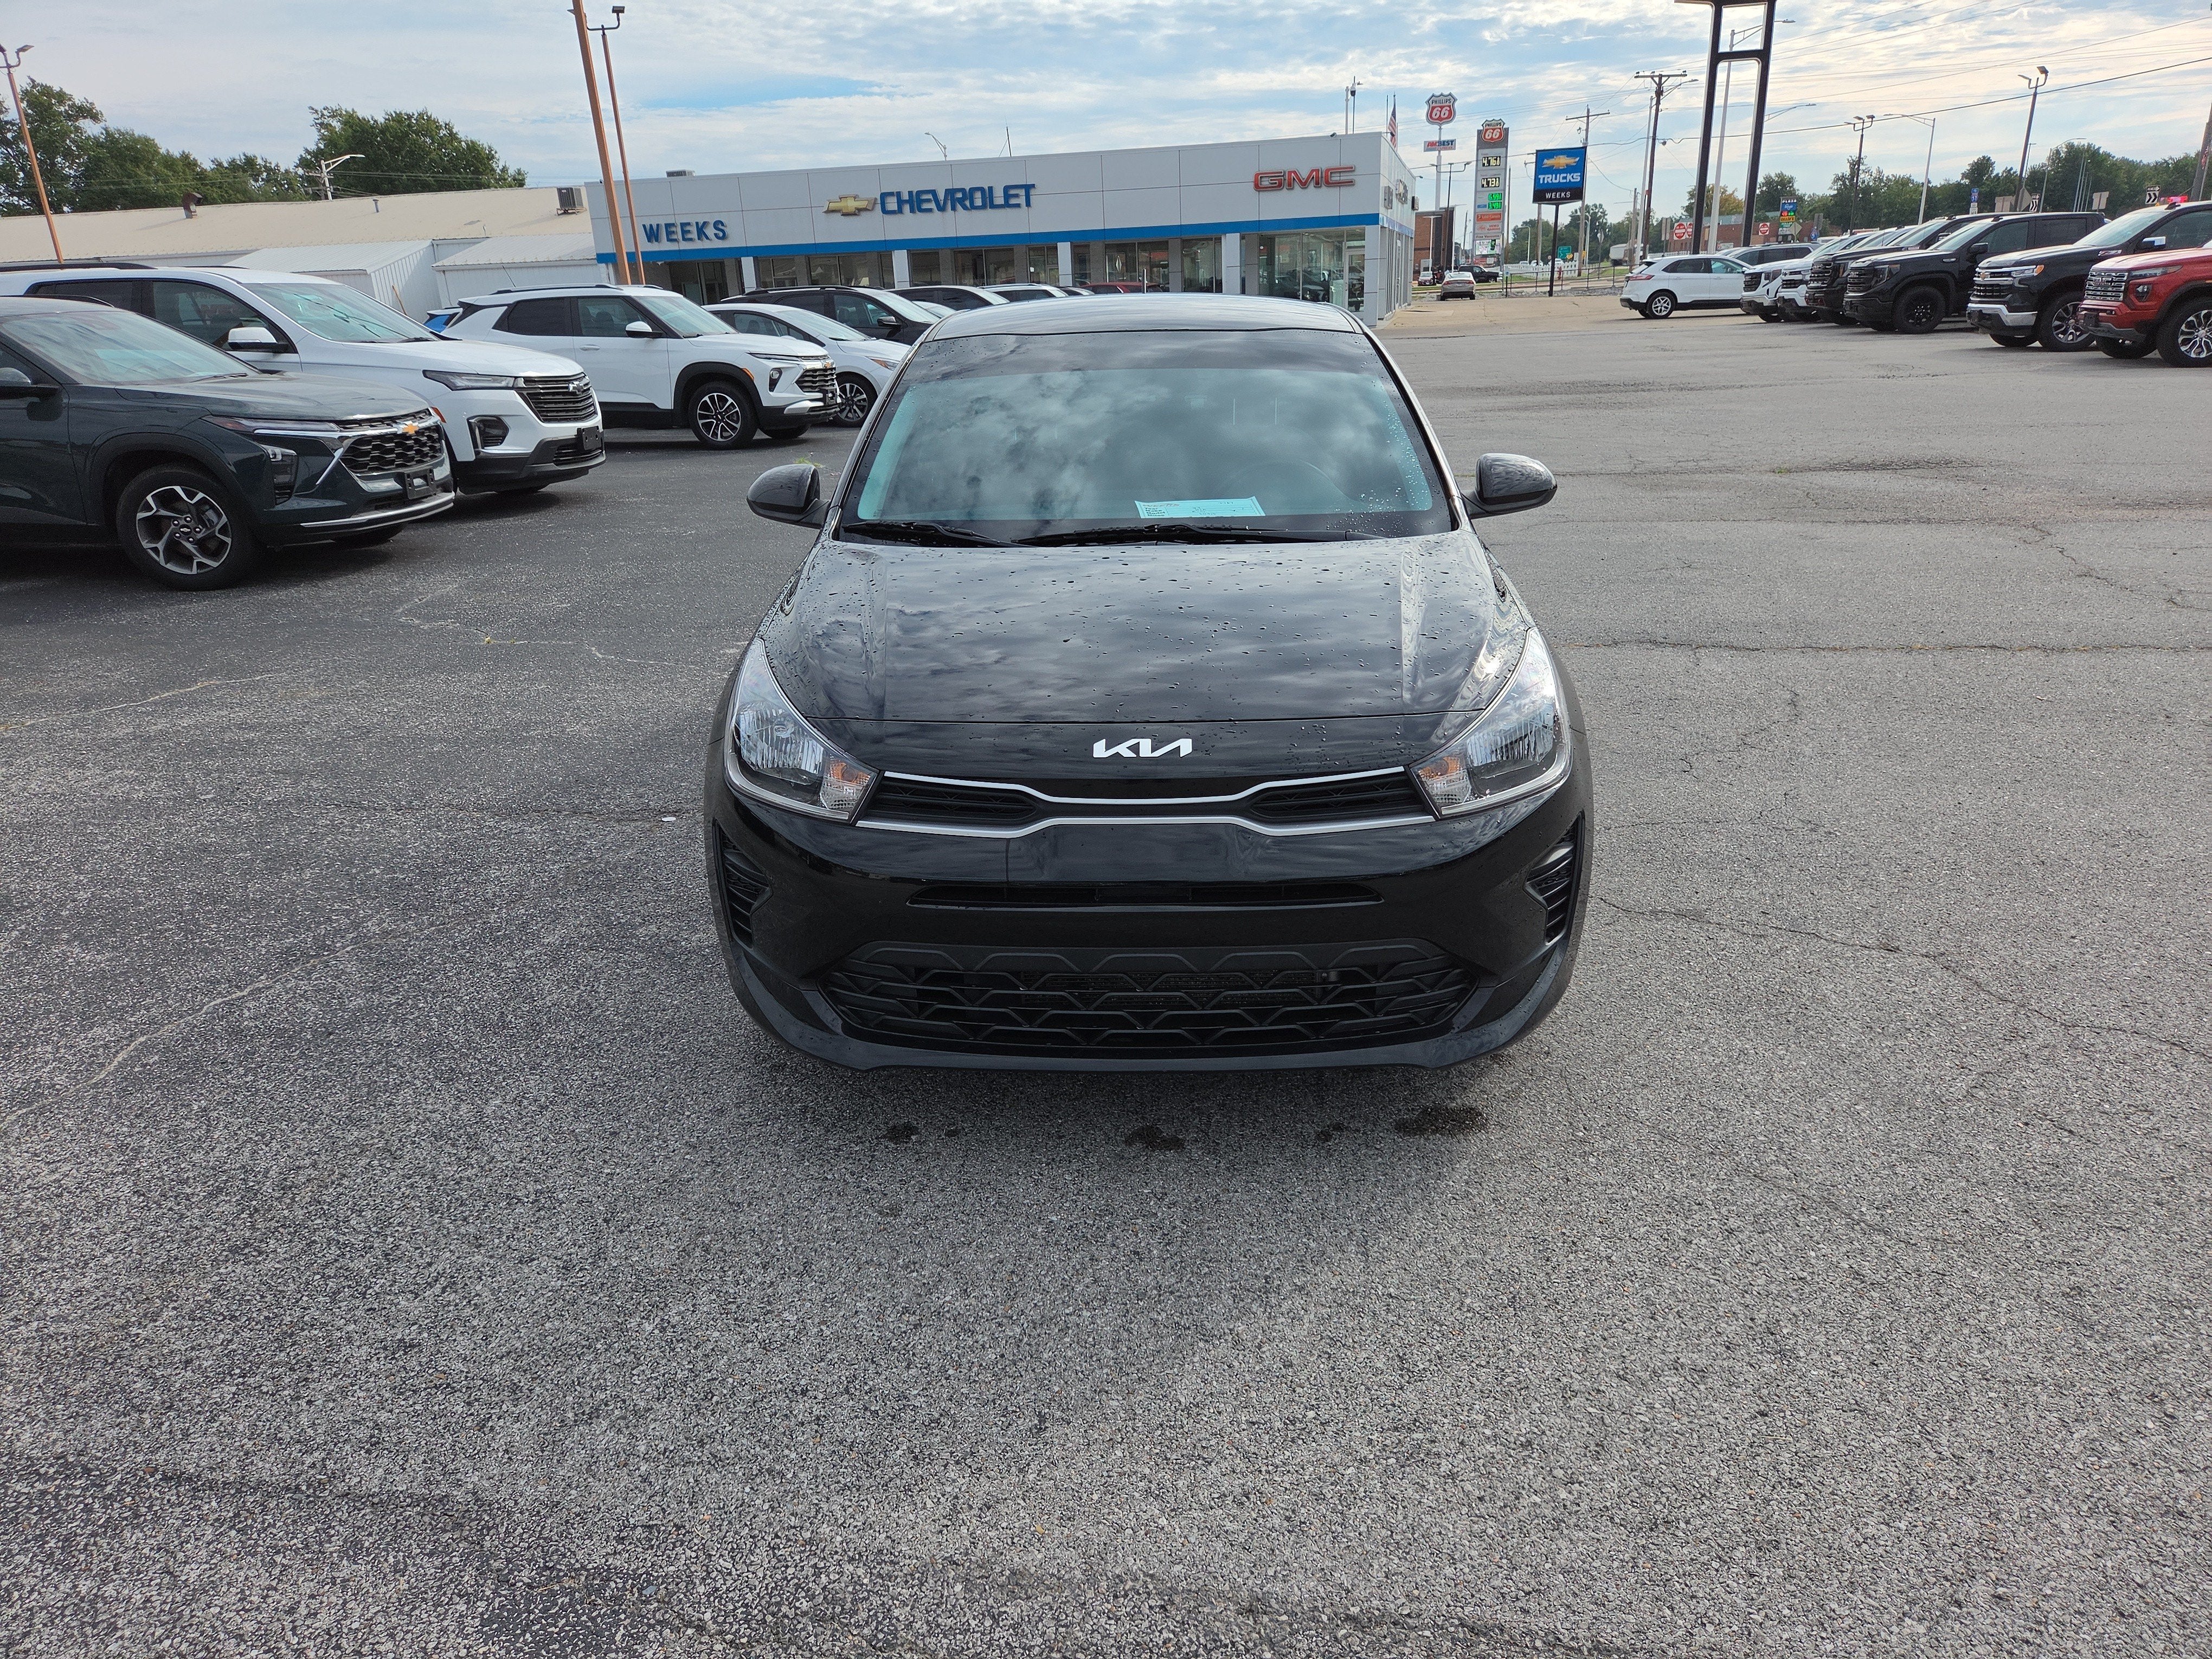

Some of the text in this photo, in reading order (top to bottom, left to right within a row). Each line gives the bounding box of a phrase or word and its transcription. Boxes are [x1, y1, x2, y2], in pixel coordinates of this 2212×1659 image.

[1432, 106, 1450, 119] 66
[1485, 129, 1501, 139] 66
[1253, 165, 1355, 191] GMC
[1538, 172, 1580, 183] TRUCKS
[880, 184, 1036, 215] CHEVROLET
[642, 220, 727, 243] WEEKS
